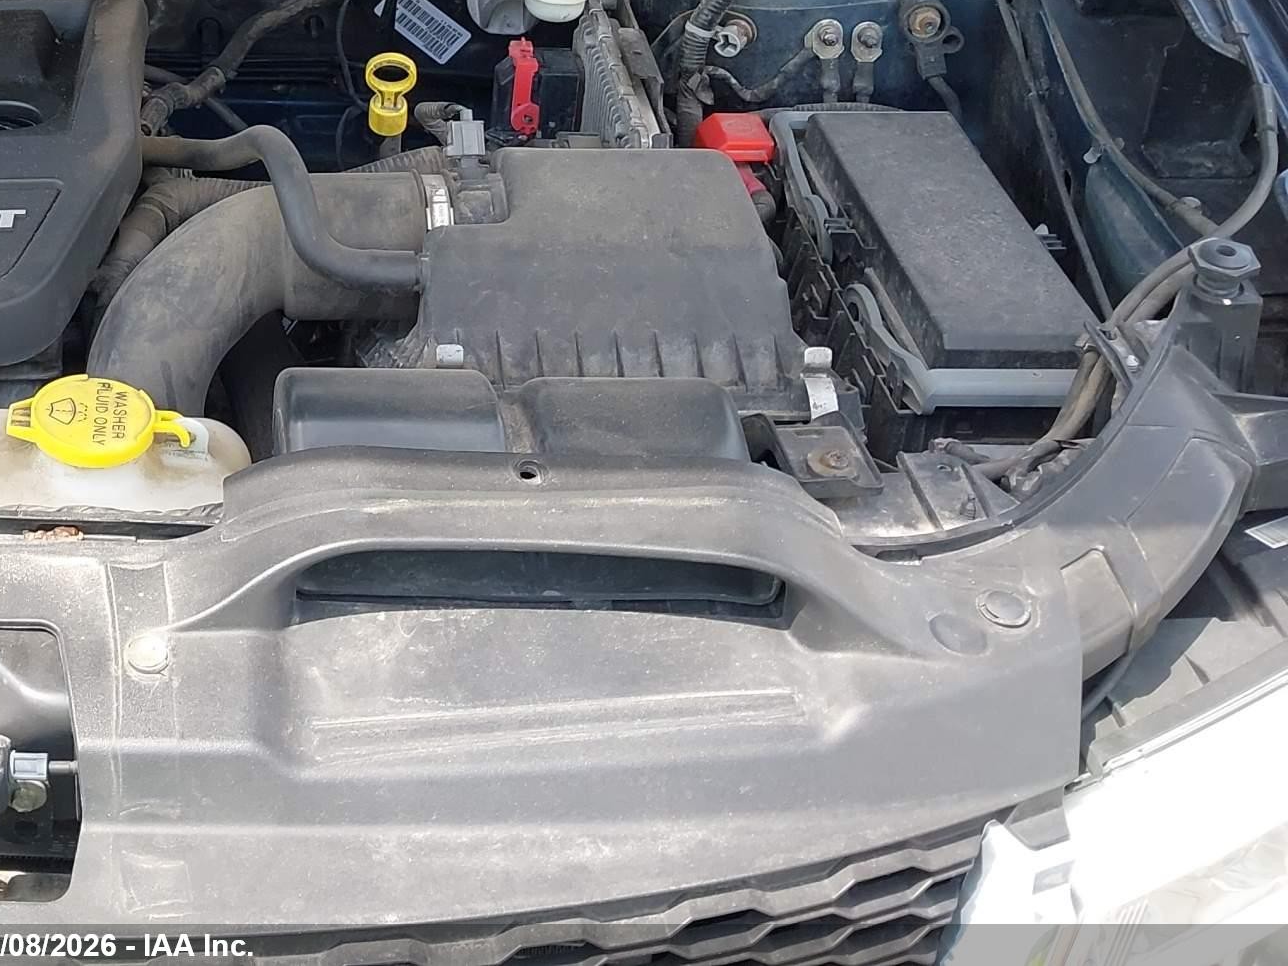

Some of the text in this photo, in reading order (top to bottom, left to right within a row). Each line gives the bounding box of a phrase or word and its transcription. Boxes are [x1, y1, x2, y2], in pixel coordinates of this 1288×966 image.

[92, 382, 111, 445] FLUID ONLY
[111, 391, 128, 439] WASHER
